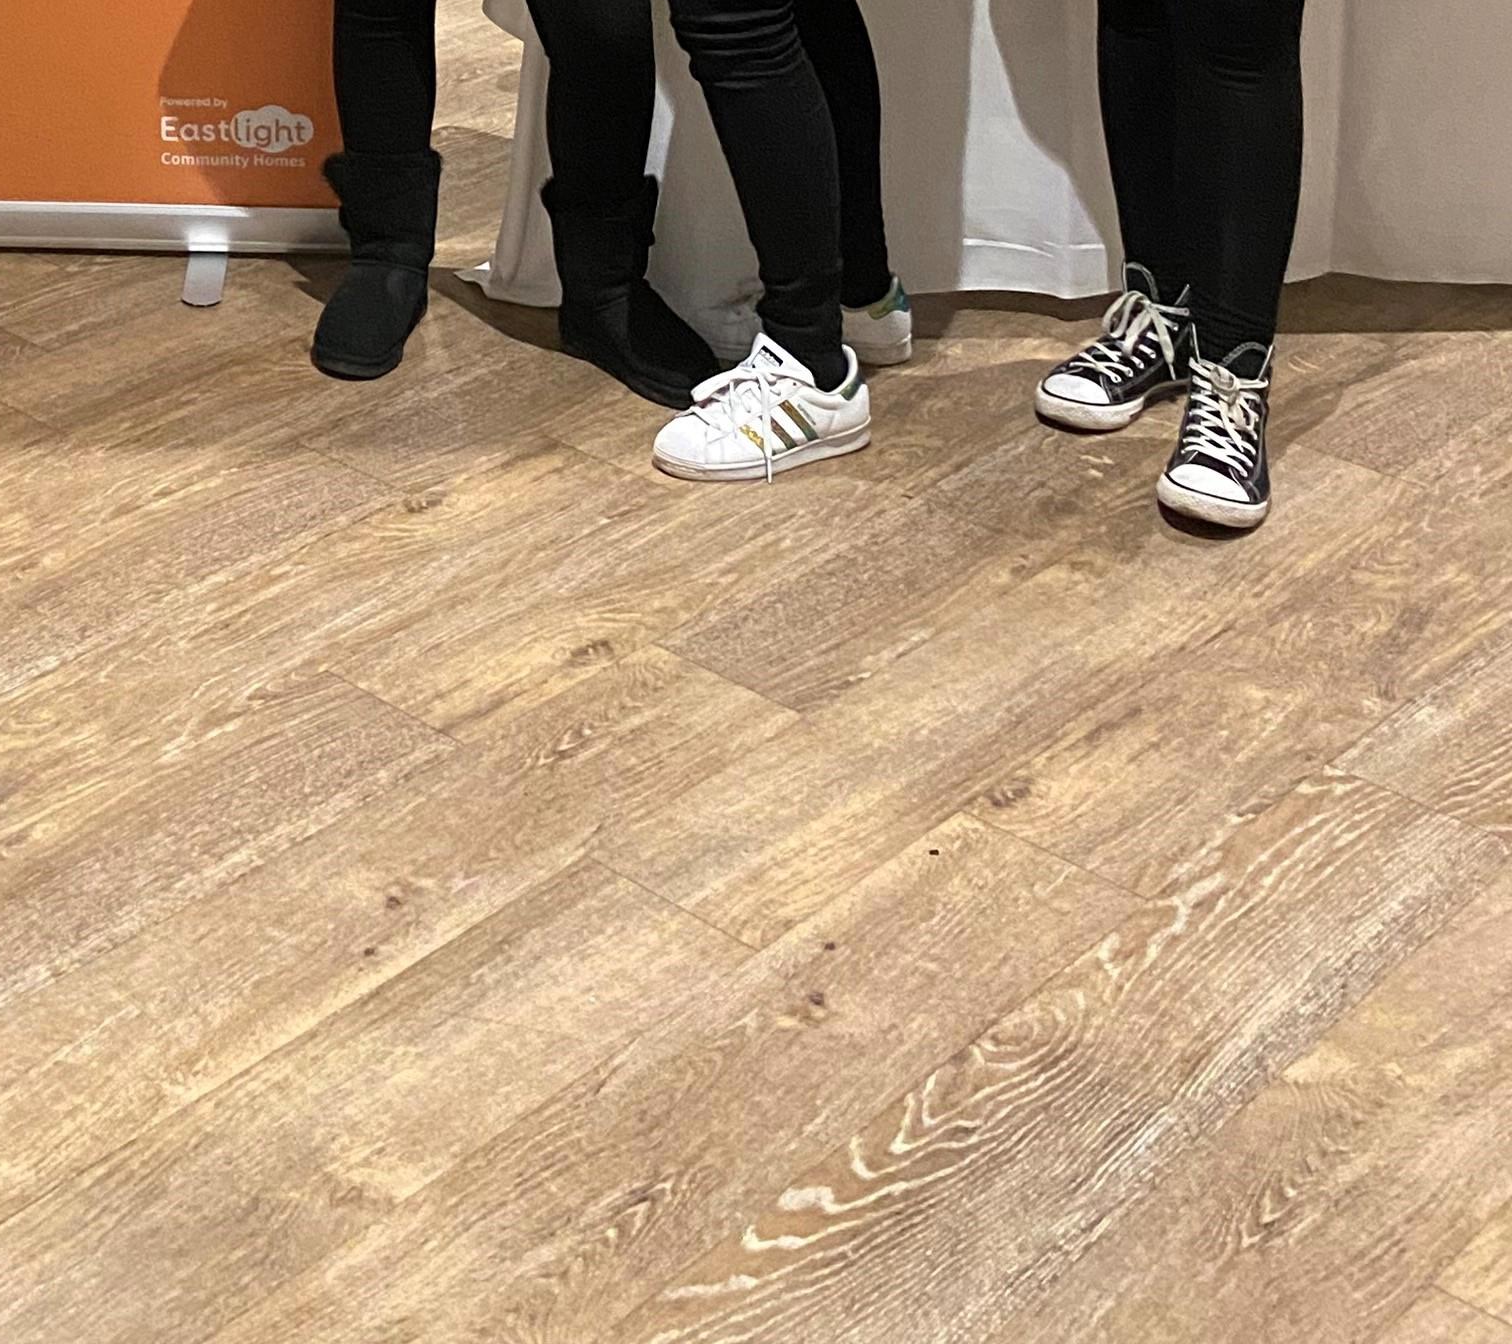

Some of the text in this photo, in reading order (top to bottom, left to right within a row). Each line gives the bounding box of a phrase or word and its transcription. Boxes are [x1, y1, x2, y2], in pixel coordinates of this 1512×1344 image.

[159, 96, 229, 109] Powered by
[159, 115, 307, 148] Eastlight
[160, 152, 306, 169] Community Homes
